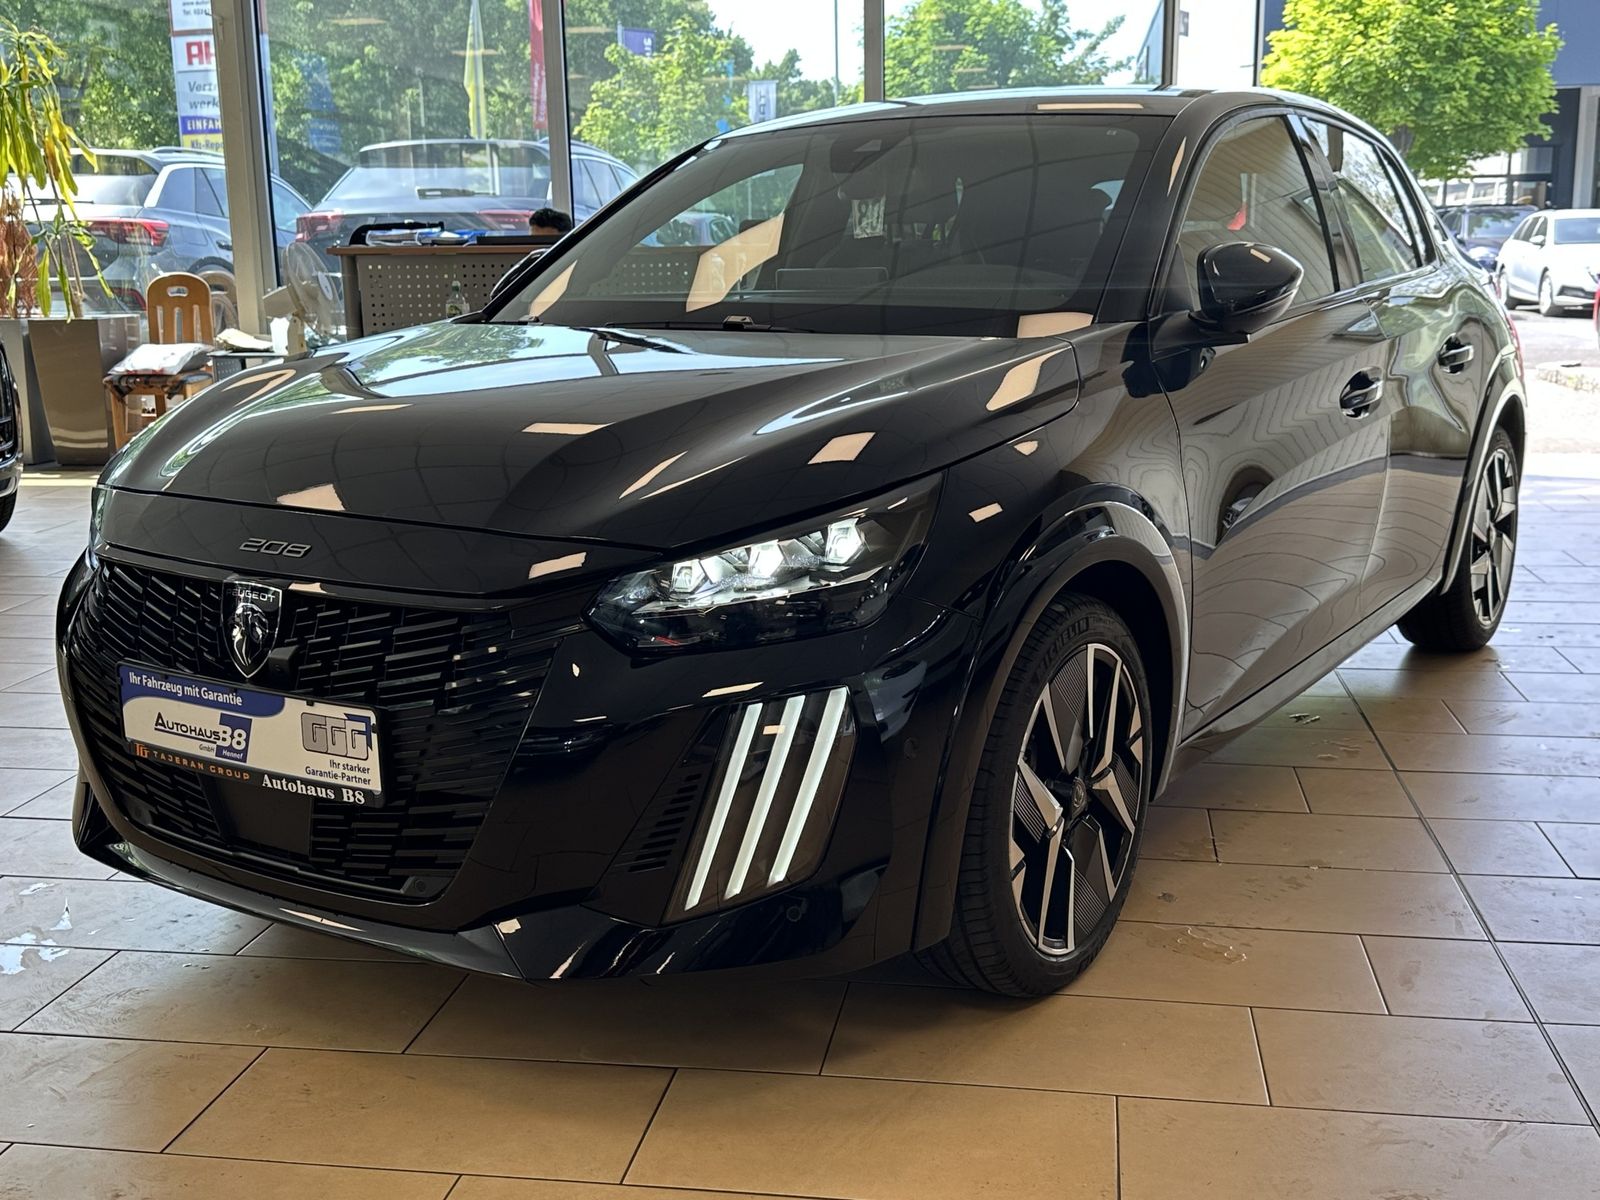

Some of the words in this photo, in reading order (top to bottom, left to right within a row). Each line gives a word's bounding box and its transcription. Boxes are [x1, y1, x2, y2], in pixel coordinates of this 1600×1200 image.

[239, 537, 312, 558] 208
[226, 587, 276, 603] PEUGEOT
[129, 671, 141, 685] Ihr
[142, 674, 182, 696] Fahrzeug
[184, 684, 200, 698] mit
[201, 687, 242, 706] Garantie
[199, 743, 216, 753] GmbH
[222, 749, 244, 760] Hennef
[153, 750, 205, 770] TAJERAN
[209, 765, 251, 780] GROUP
[304, 765, 371, 786] Garantie-Partner
[329, 759, 341, 769] Ihr
[342, 761, 371, 774] starker
[261, 774, 336, 800] Autohaus
[341, 787, 366, 805] B8
